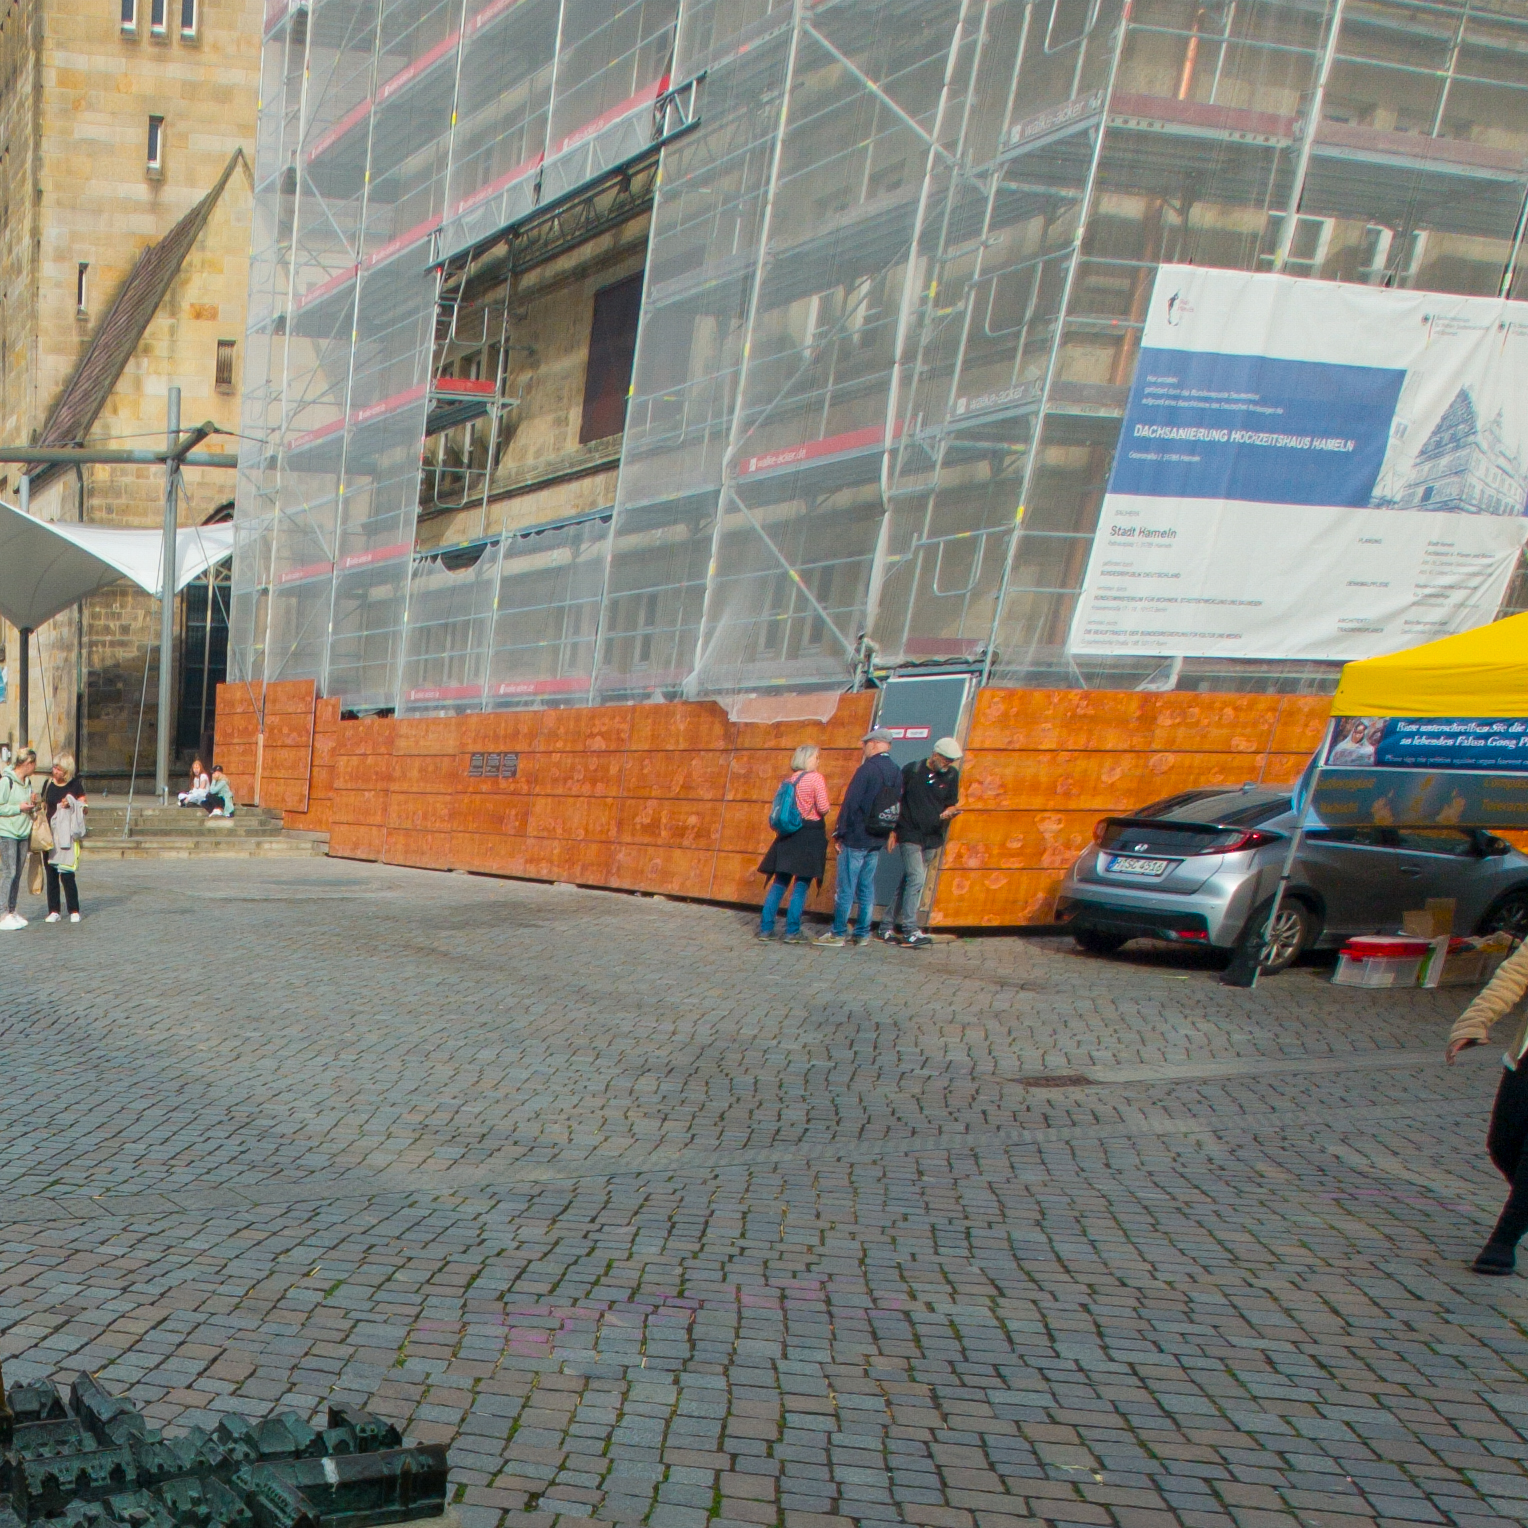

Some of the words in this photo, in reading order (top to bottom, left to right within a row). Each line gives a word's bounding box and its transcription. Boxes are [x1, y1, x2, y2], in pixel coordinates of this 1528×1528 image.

[1132, 423, 1229, 442] DACHSANIERUNG
[1228, 430, 1311, 448] HOCHZEITSHAUS
[1310, 437, 1355, 452] HAMELN
[1109, 525, 1137, 537] Stadt
[1137, 526, 1178, 539] Hameln
[1487, 735, 1517, 750] Gong
